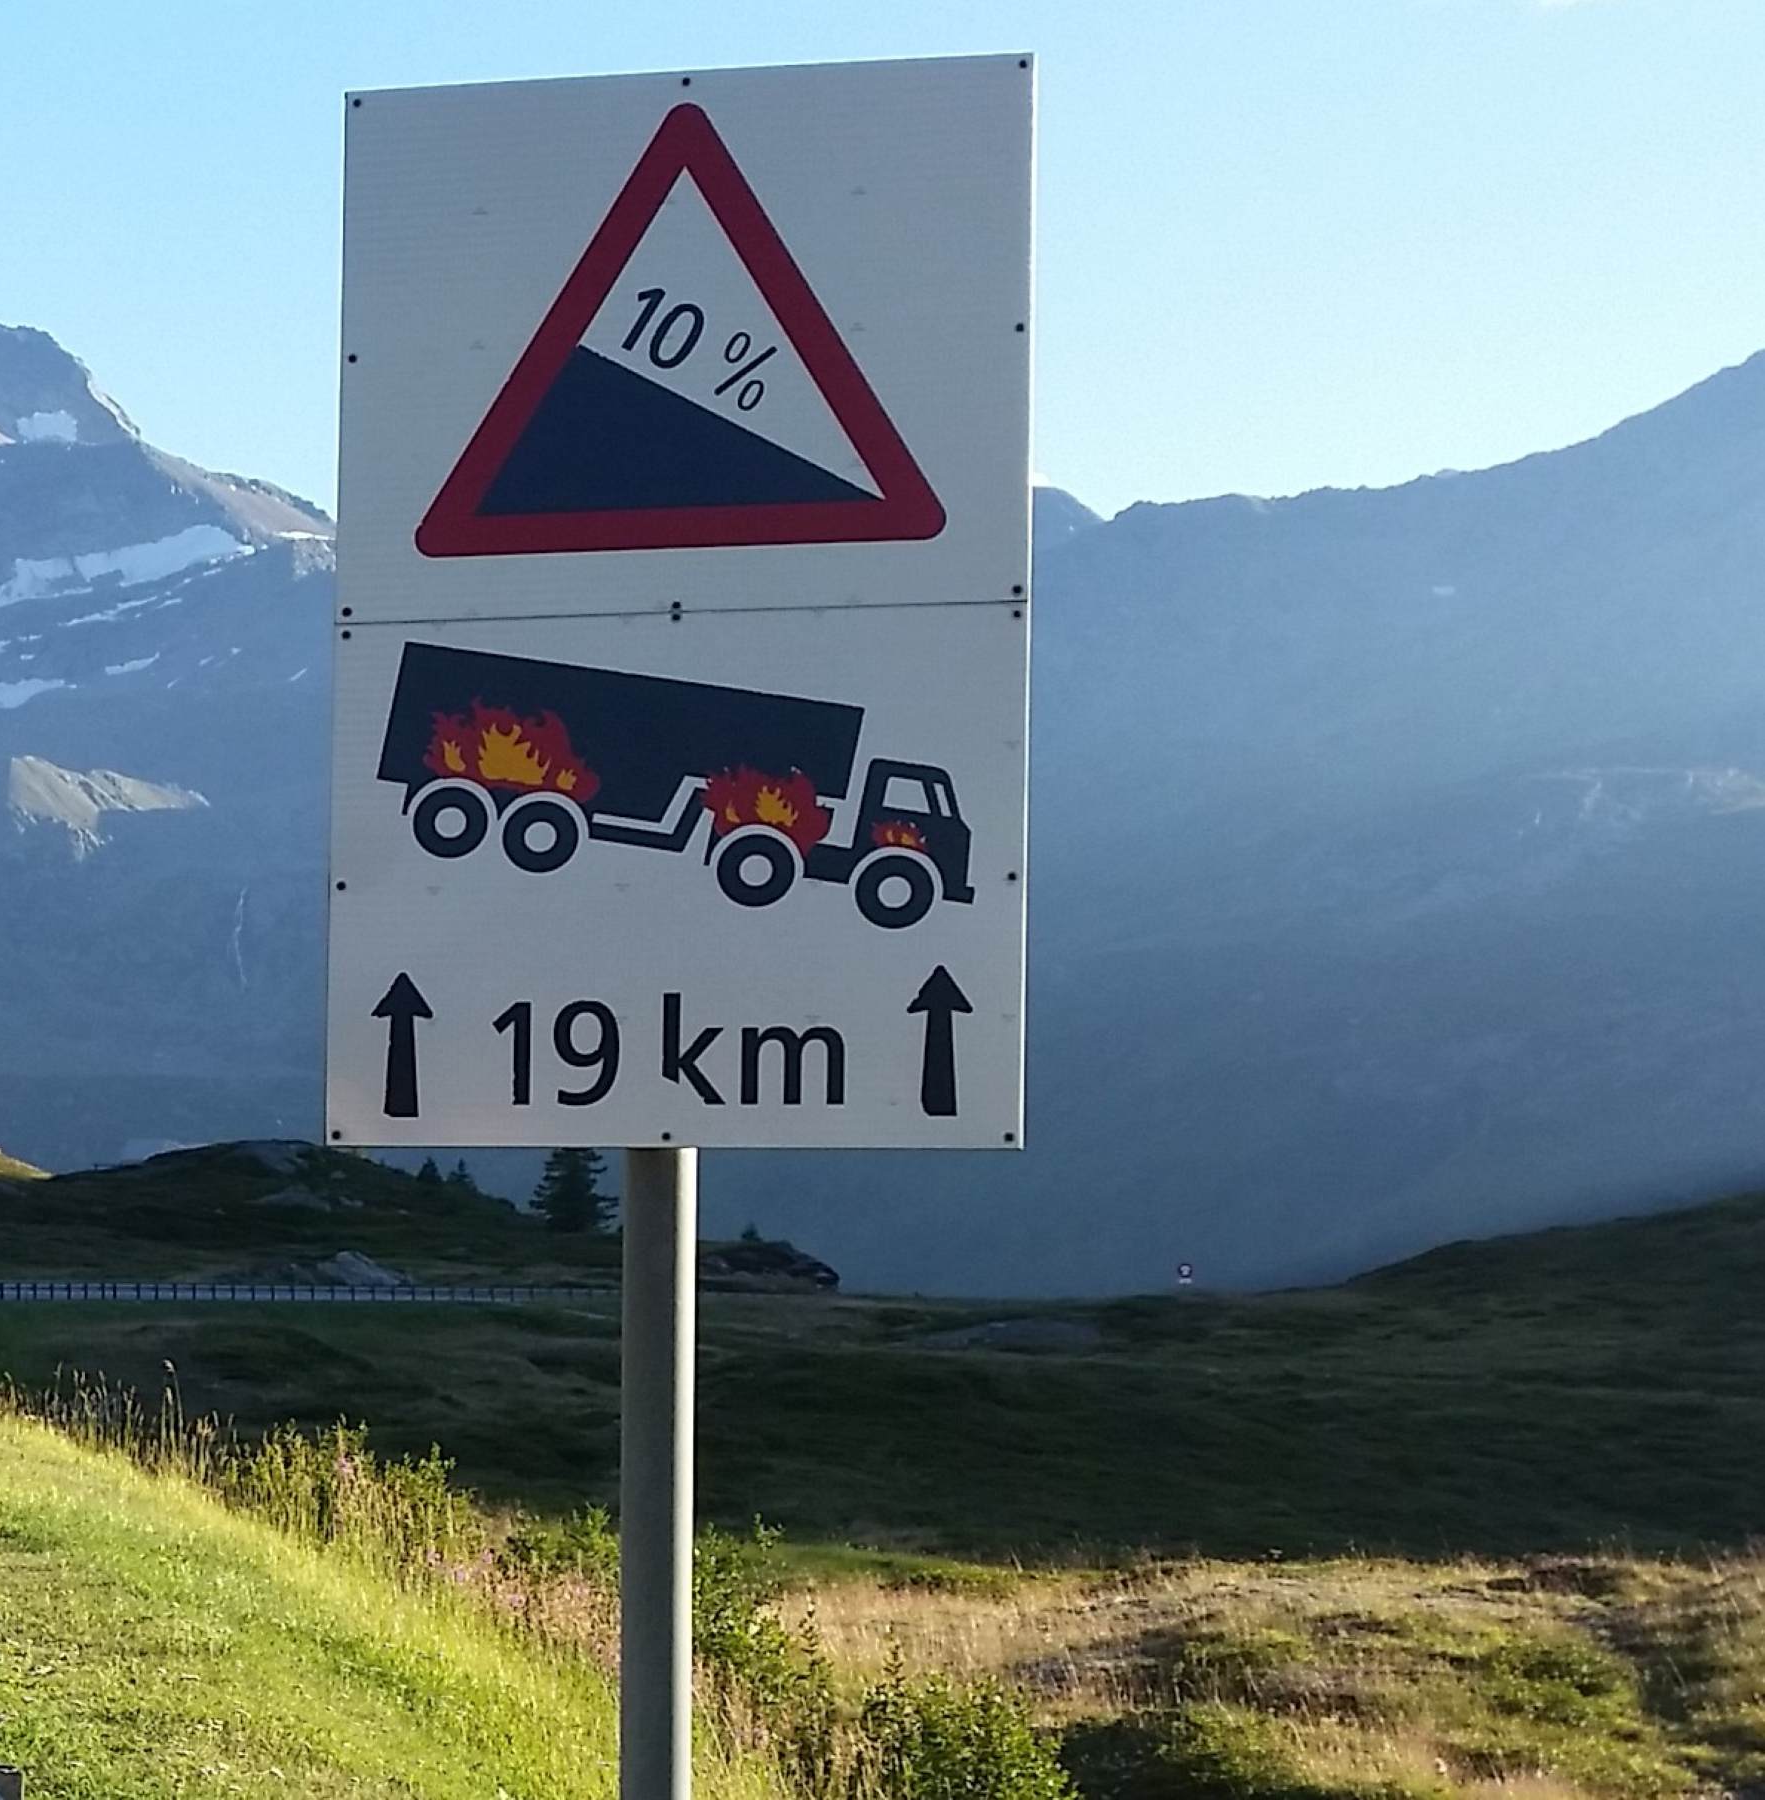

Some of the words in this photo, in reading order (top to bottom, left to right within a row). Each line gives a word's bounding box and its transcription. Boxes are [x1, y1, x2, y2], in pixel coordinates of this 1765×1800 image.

[622, 288, 705, 369] 10
[714, 332, 777, 411] %
[492, 1000, 620, 1106] 19
[661, 991, 845, 1106] km
